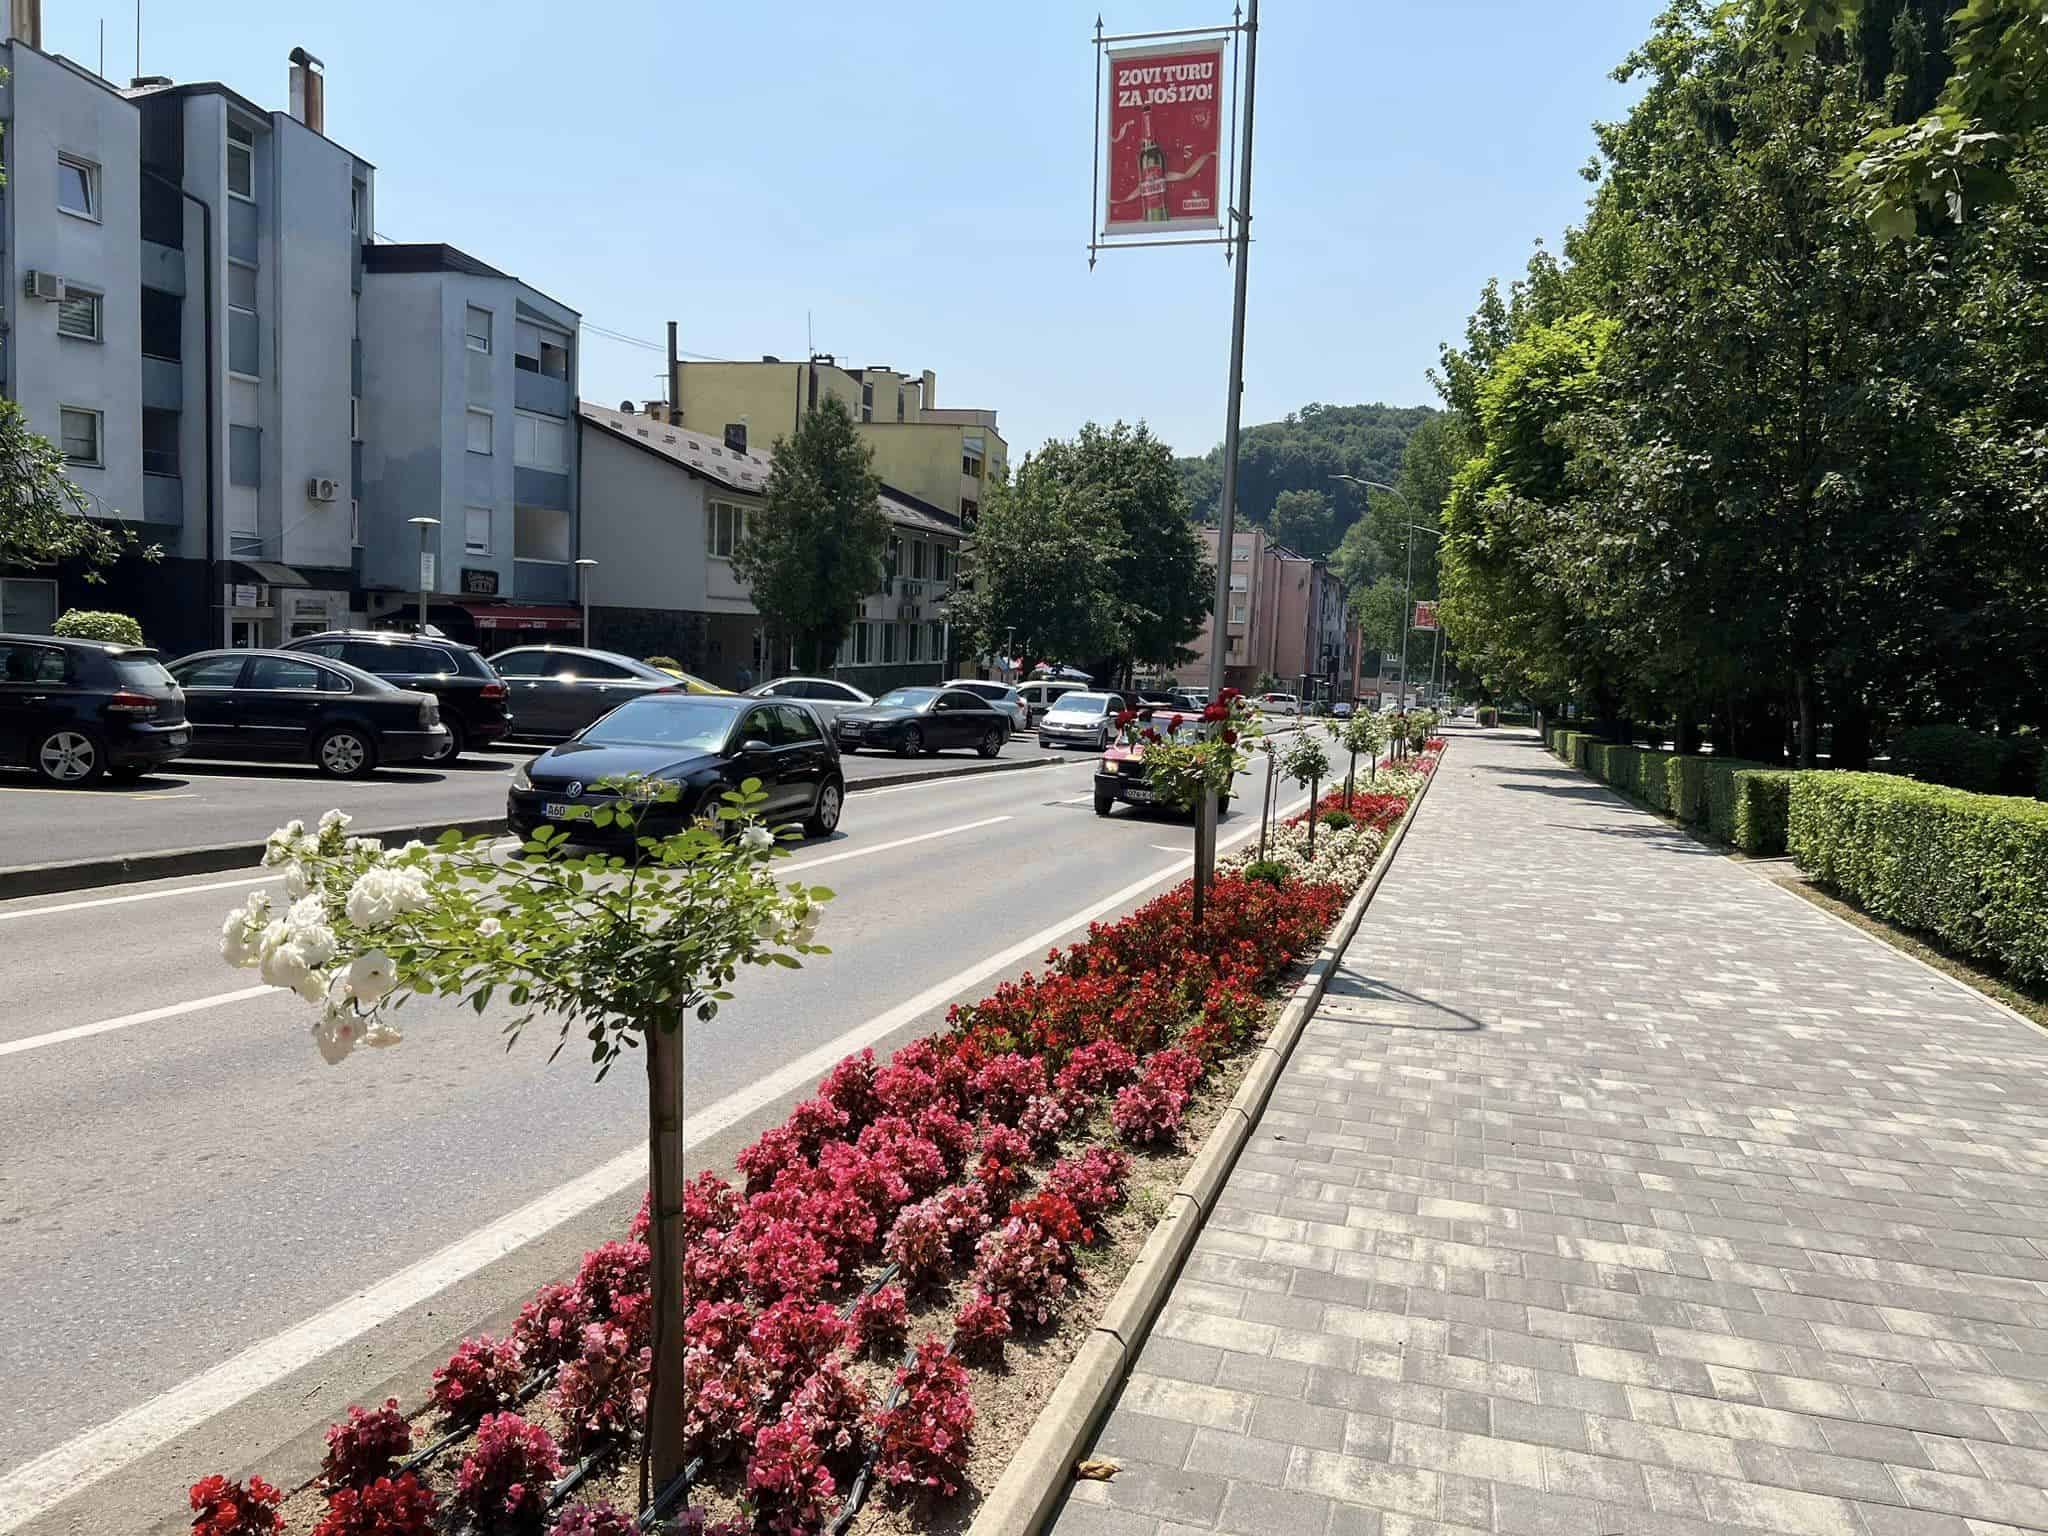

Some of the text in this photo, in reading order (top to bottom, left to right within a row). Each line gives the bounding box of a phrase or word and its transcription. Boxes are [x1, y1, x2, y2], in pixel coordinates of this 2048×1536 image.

[1119, 63, 1213, 86] ZOVI TURU
[1119, 83, 1213, 107] ZA JOŠ 170!
